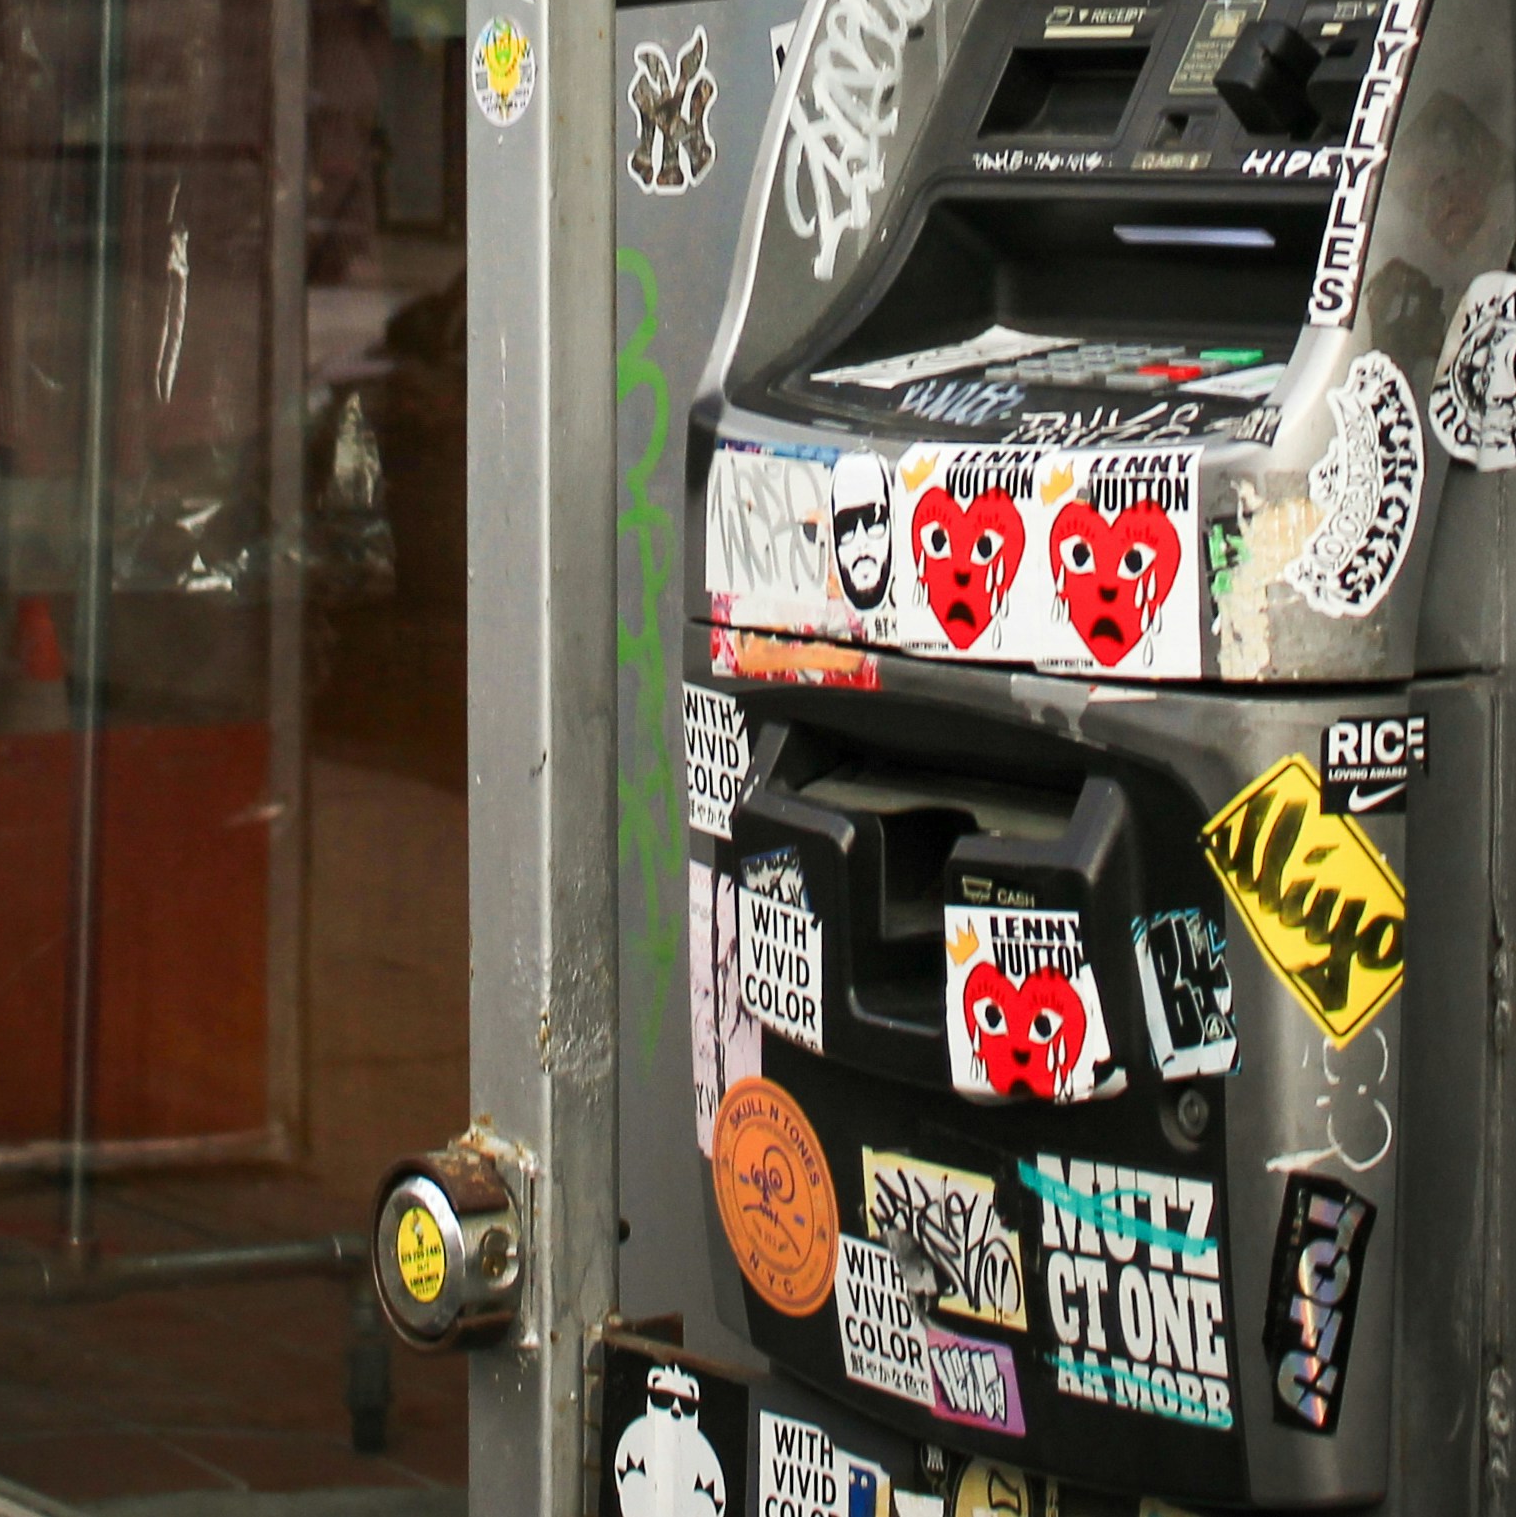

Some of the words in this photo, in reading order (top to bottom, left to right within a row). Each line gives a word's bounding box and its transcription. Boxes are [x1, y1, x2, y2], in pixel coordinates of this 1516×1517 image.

[1090, 6, 1147, 24] RECEIPT
[1089, 476, 1190, 513] VUITTON
[683, 690, 734, 734] WITH
[685, 726, 740, 770] VIVID
[1327, 717, 1425, 766] RICE
[1327, 765, 1369, 782] LOVING
[997, 887, 1035, 908] CASH
[751, 899, 808, 951] WITH
[990, 914, 1083, 942] LENNY
[751, 936, 811, 989] VIVID
[745, 974, 816, 1032] COLOR
[729, 1098, 765, 1129] SKULL
[770, 1102, 779, 1123] N
[783, 1116, 820, 1188] TONES
[1036, 1152, 1220, 1280] MUTZ
[843, 1241, 908, 1295] WITH
[846, 1279, 913, 1329] VIVID
[1047, 1250, 1109, 1352] CT
[1118, 1264, 1229, 1378] ONE
[845, 1315, 924, 1372] COLOR
[1057, 1344, 1109, 1404] AA
[773, 1420, 835, 1470] WITH
[772, 1458, 837, 1507] VIVID
